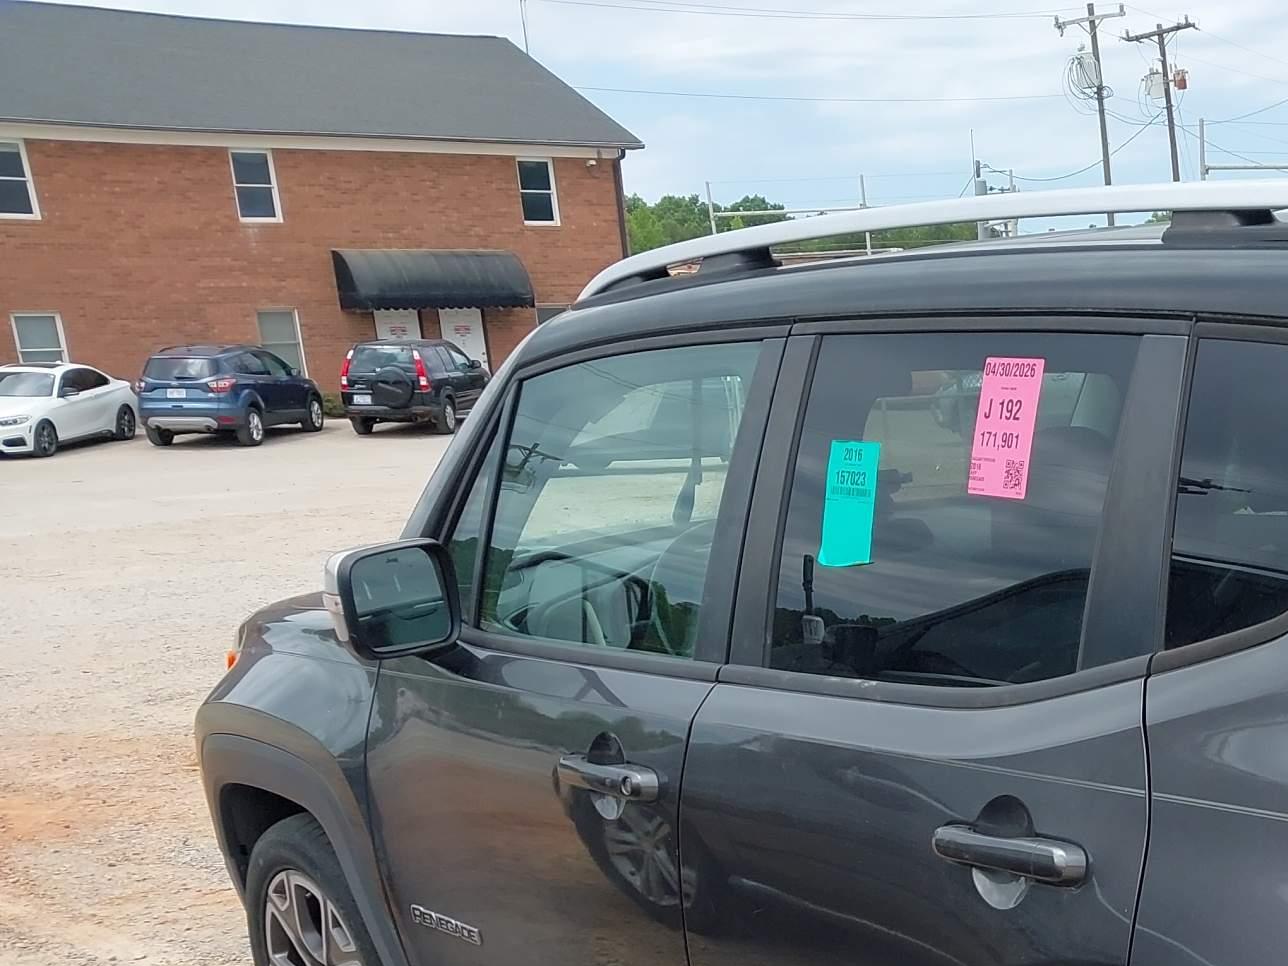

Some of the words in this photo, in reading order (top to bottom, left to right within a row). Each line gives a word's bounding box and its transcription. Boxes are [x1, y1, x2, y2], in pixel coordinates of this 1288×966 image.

[985, 362, 1037, 378] 04/30/2026
[984, 398, 993, 419] J
[999, 399, 1022, 421] 192
[980, 431, 1020, 451] 171,901
[844, 447, 863, 461] 2016
[836, 470, 867, 486] 157023
[410, 904, 482, 945] RENEGADE
